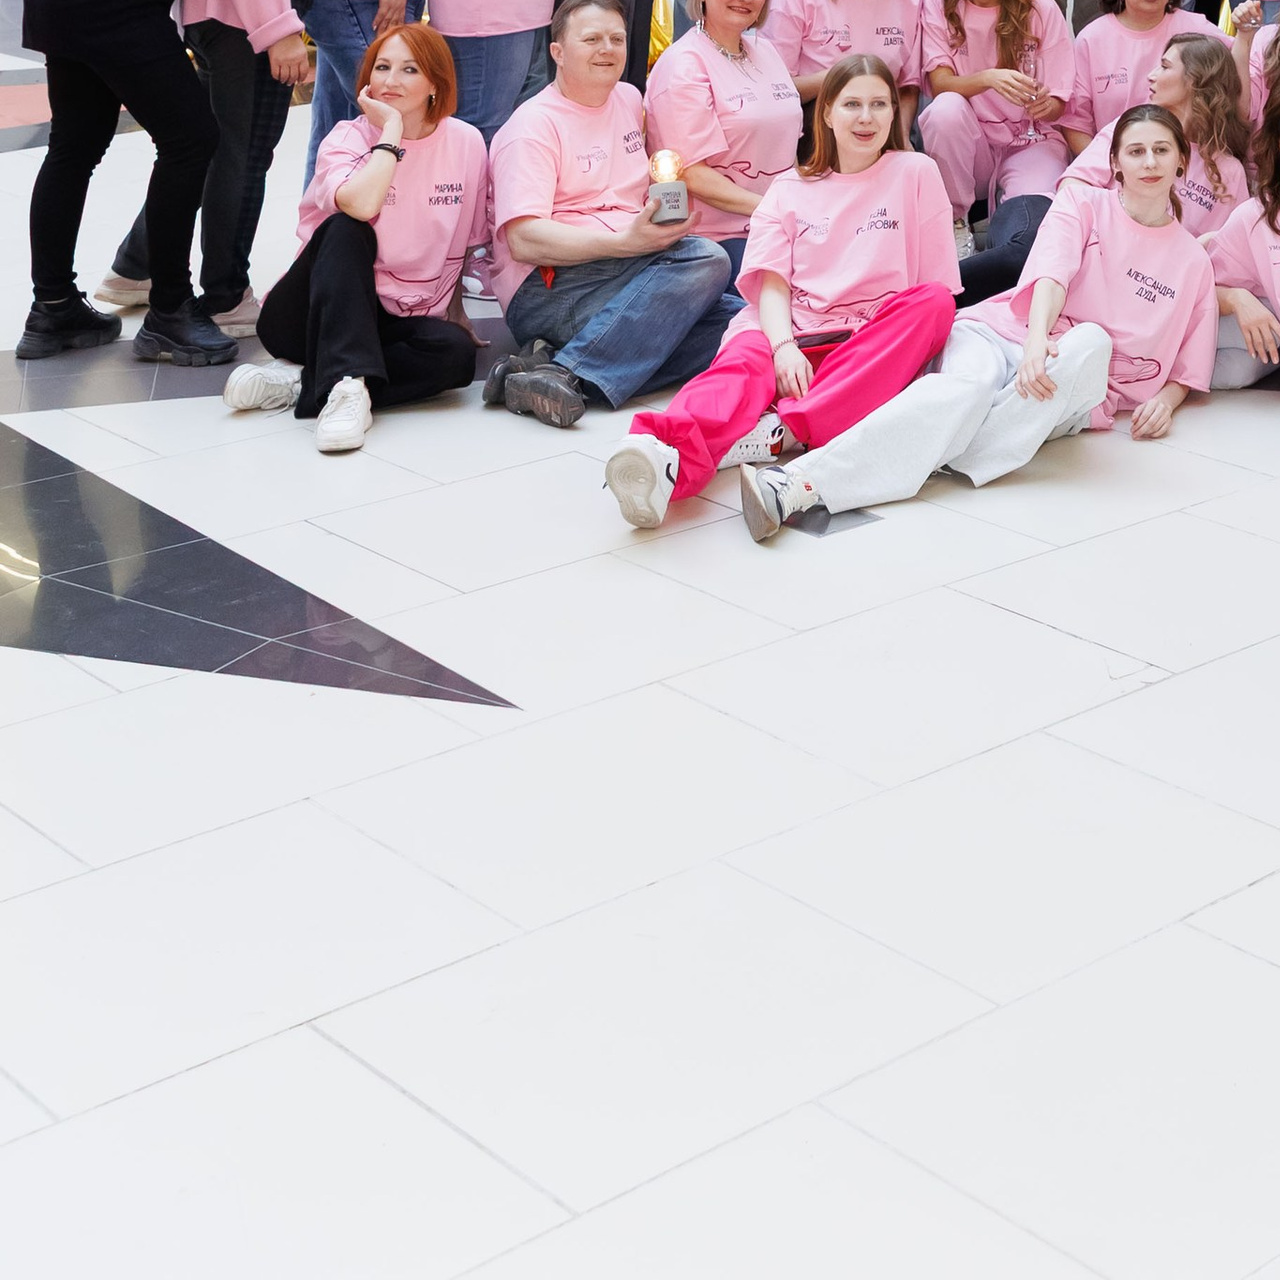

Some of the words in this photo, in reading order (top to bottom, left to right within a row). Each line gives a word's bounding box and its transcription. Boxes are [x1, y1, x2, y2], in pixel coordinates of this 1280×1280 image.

[435, 183, 463, 193] МАРИНА
[1126, 268, 1177, 300] АЛЕКСАНДРА
[1135, 287, 1158, 304] ДУДА
